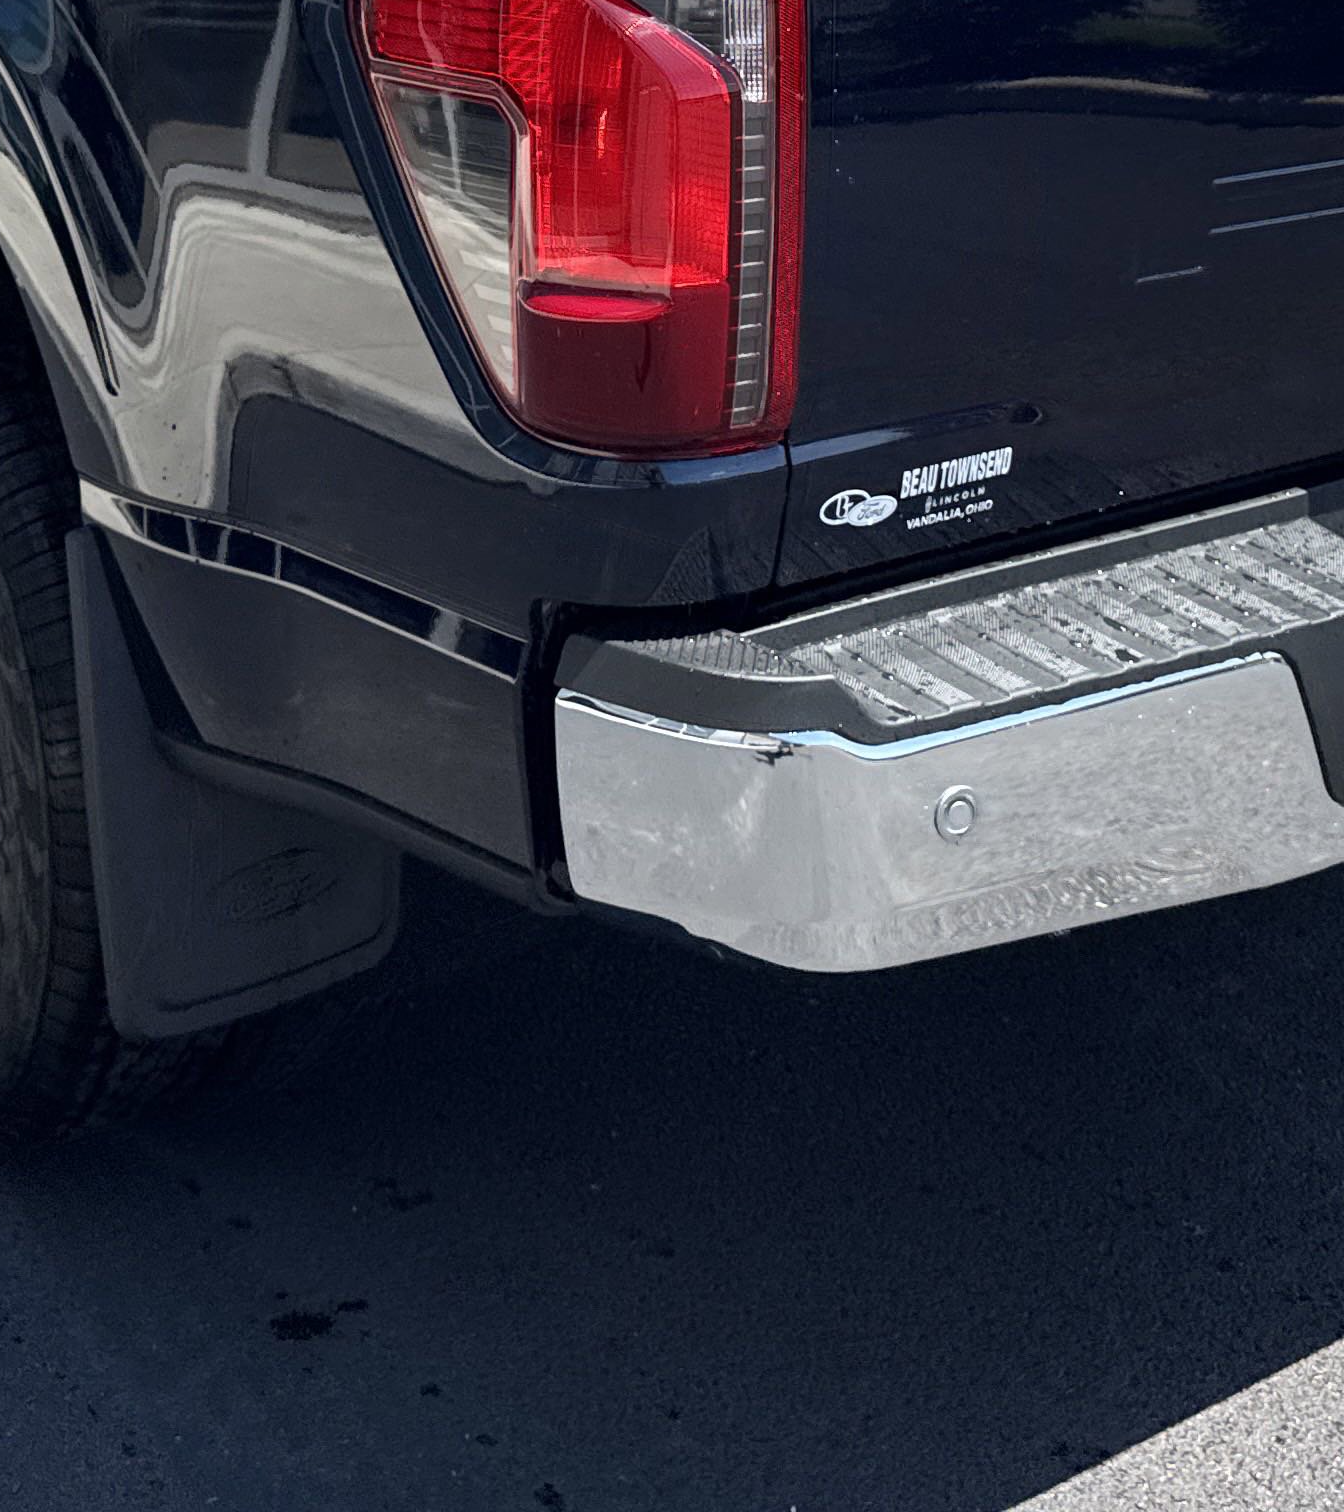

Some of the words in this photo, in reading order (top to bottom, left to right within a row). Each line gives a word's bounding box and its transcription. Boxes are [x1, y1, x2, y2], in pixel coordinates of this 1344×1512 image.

[900, 464, 939, 499] BEAU
[940, 447, 1013, 489] TOWNSEND
[932, 486, 986, 507] LINCOLN
[965, 499, 993, 515] OHIO
